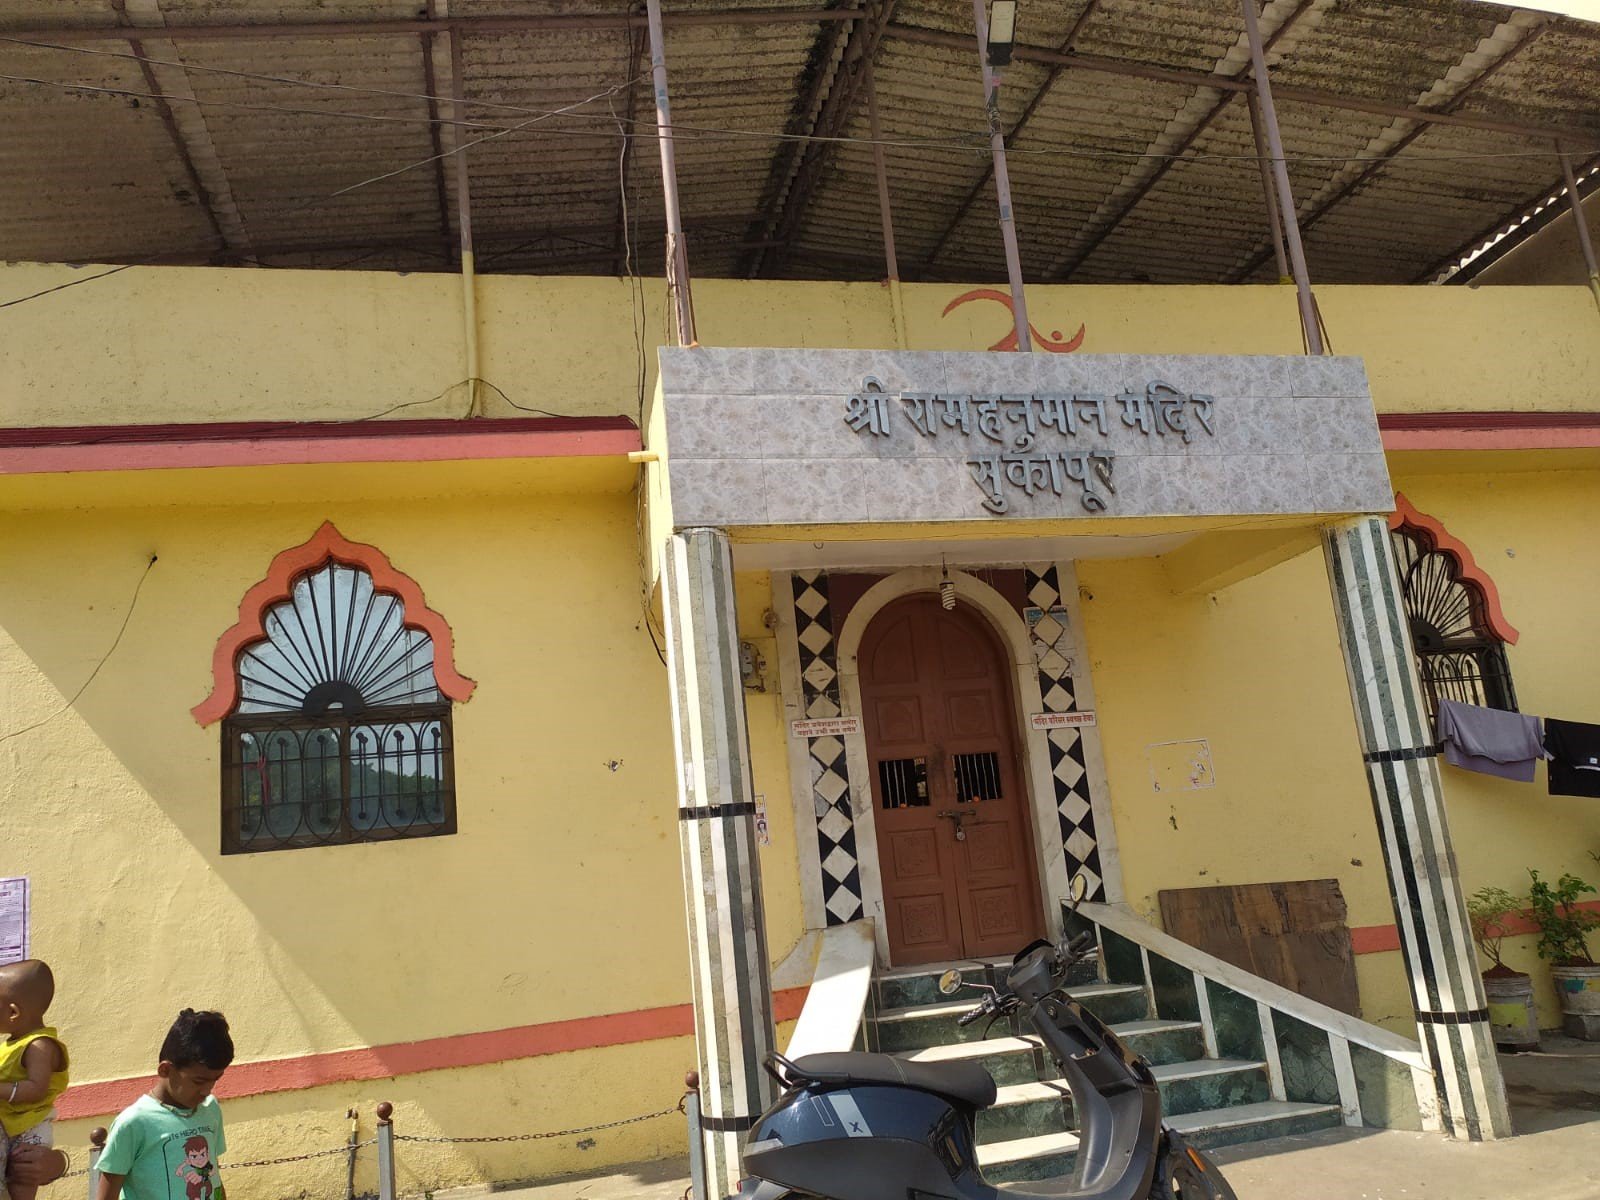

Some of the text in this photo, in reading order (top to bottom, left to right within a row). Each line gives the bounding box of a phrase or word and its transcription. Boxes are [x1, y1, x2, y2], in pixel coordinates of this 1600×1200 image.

[844, 375, 891, 437] श्री
[1115, 379, 1215, 445] मंदिर
[966, 448, 1117, 514] सुकापूर
